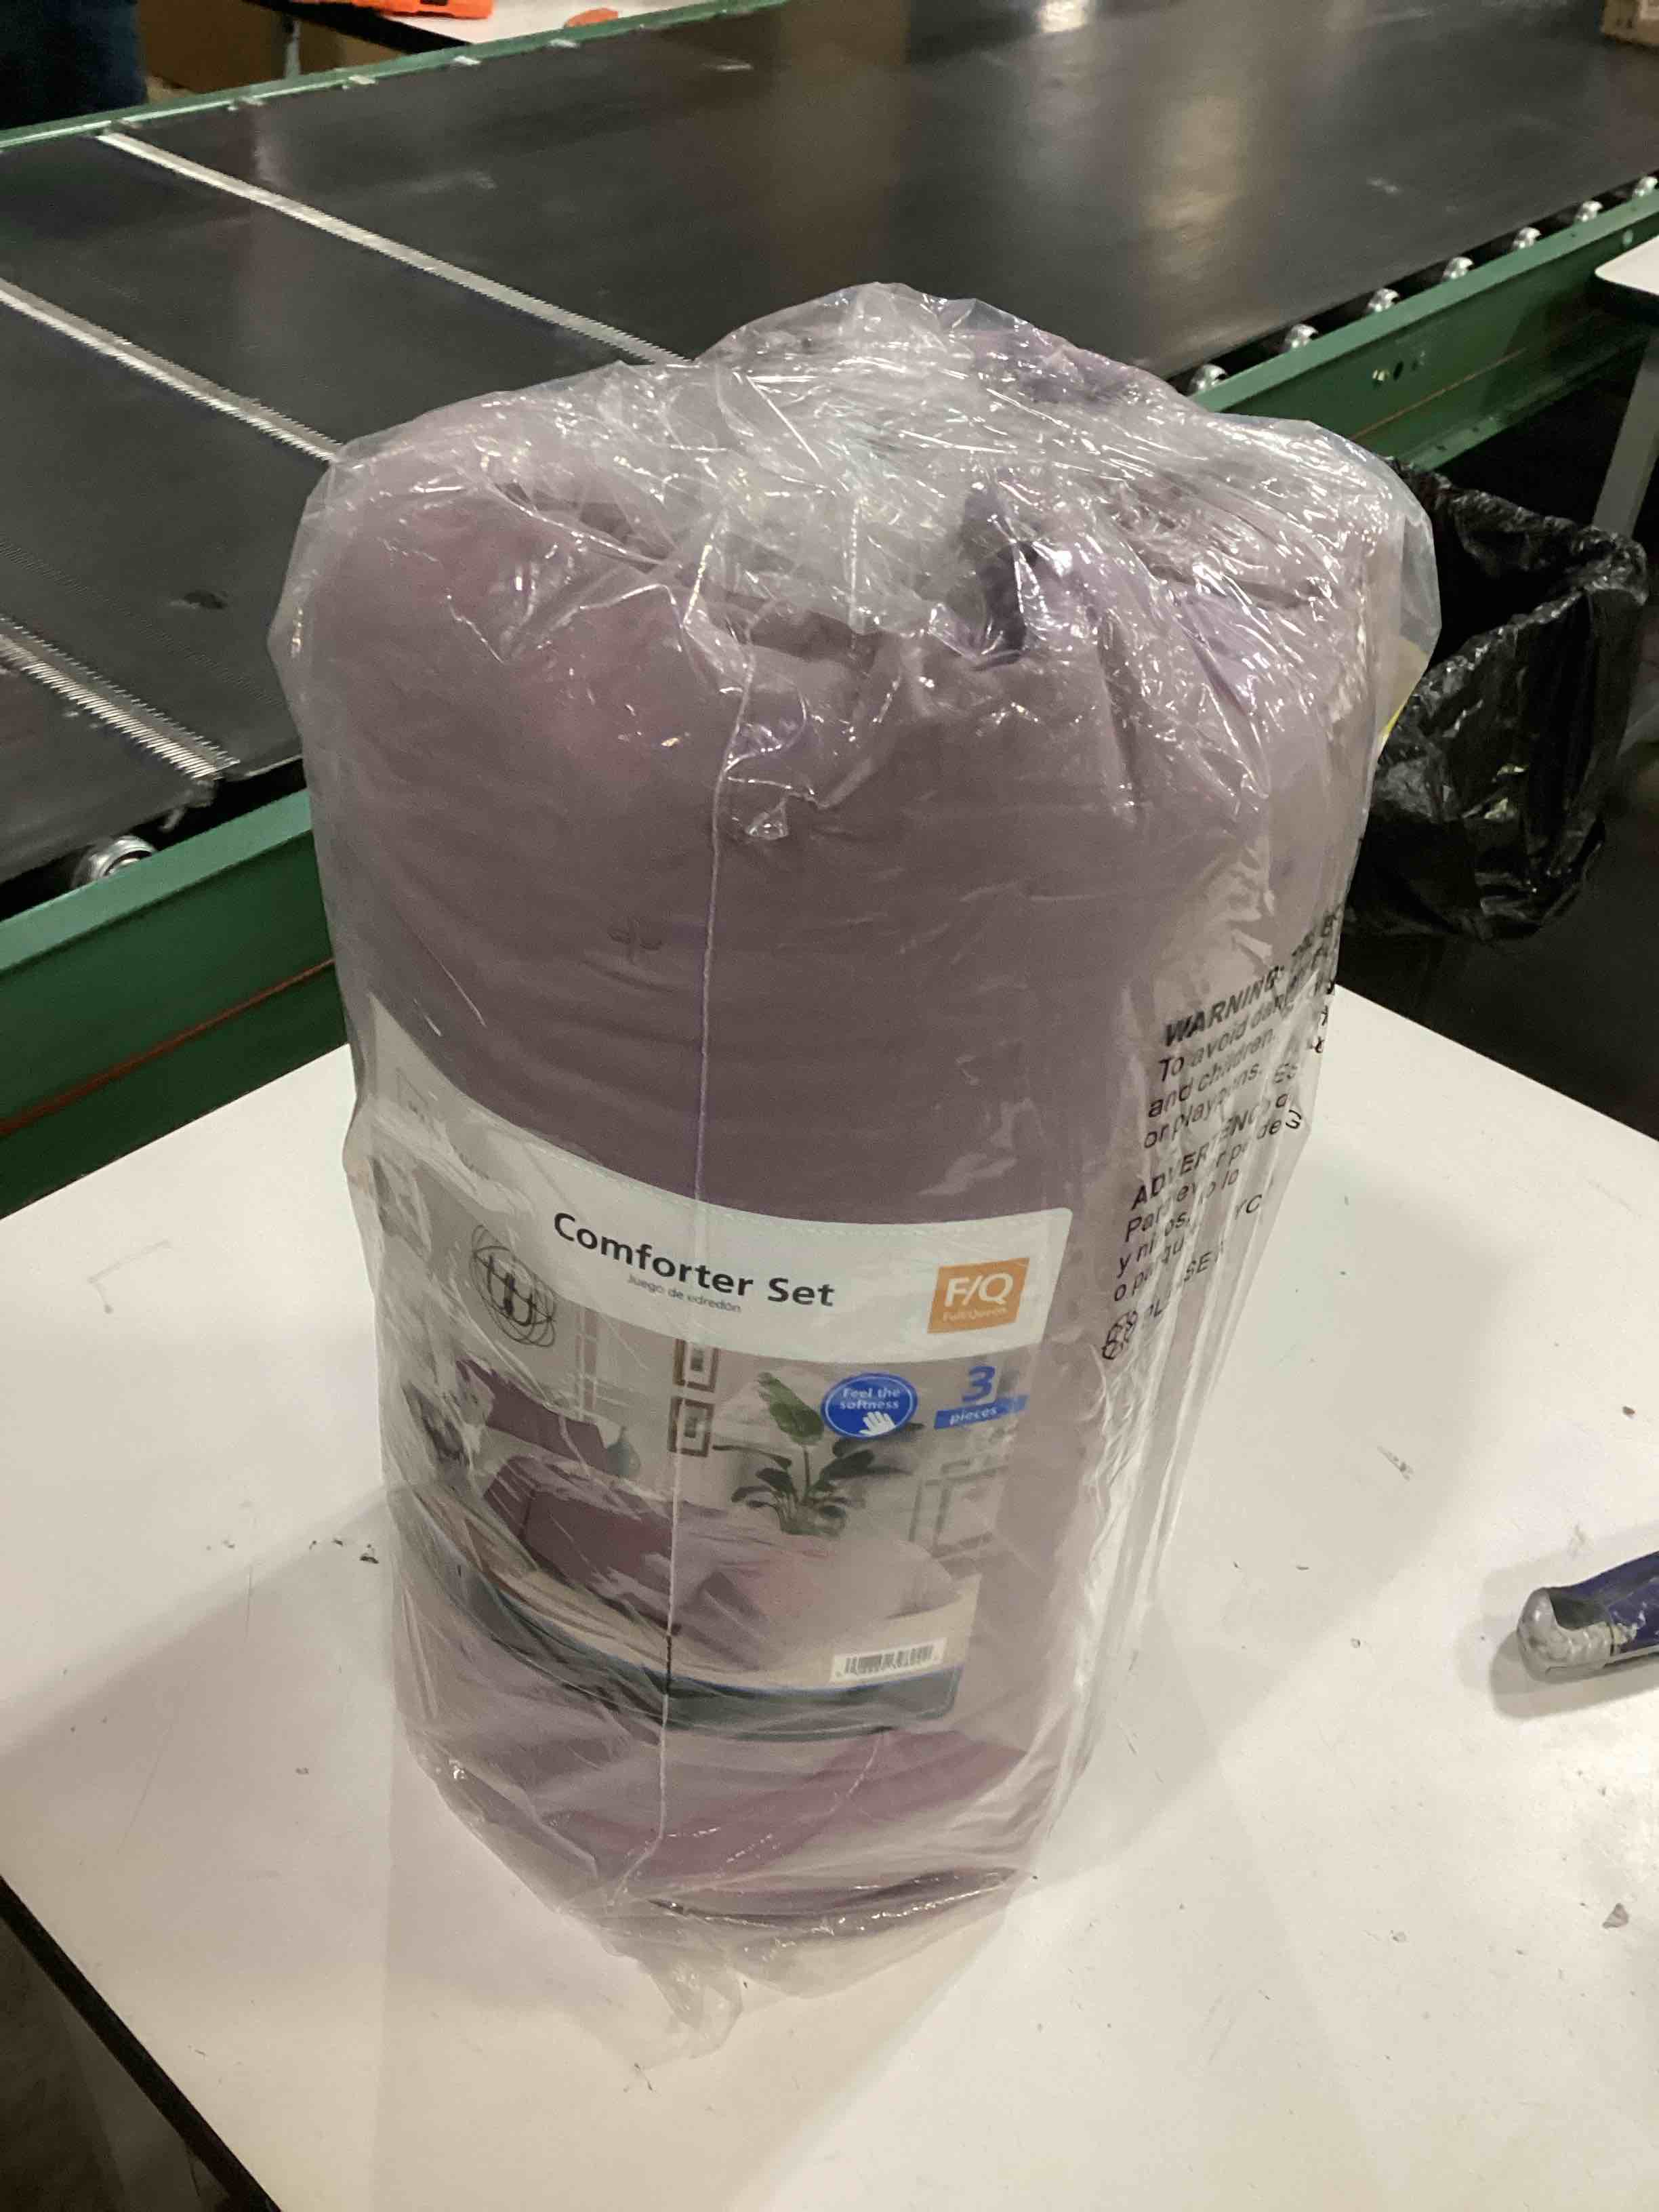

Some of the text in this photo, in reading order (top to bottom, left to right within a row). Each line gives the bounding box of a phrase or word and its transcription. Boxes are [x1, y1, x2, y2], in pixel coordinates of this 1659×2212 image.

[1158, 1057, 1185, 1082] To
[1149, 1076, 1194, 1118] and
[1144, 1124, 1169, 1149] or
[554, 1212, 835, 1307] Comforter Set
[944, 1273, 1013, 1307] F/Q
[842, 1387, 900, 1398] Feel the
[962, 1366, 996, 1402] 3
[840, 1399, 900, 1410] softness
[949, 1407, 998, 1426] pieces
